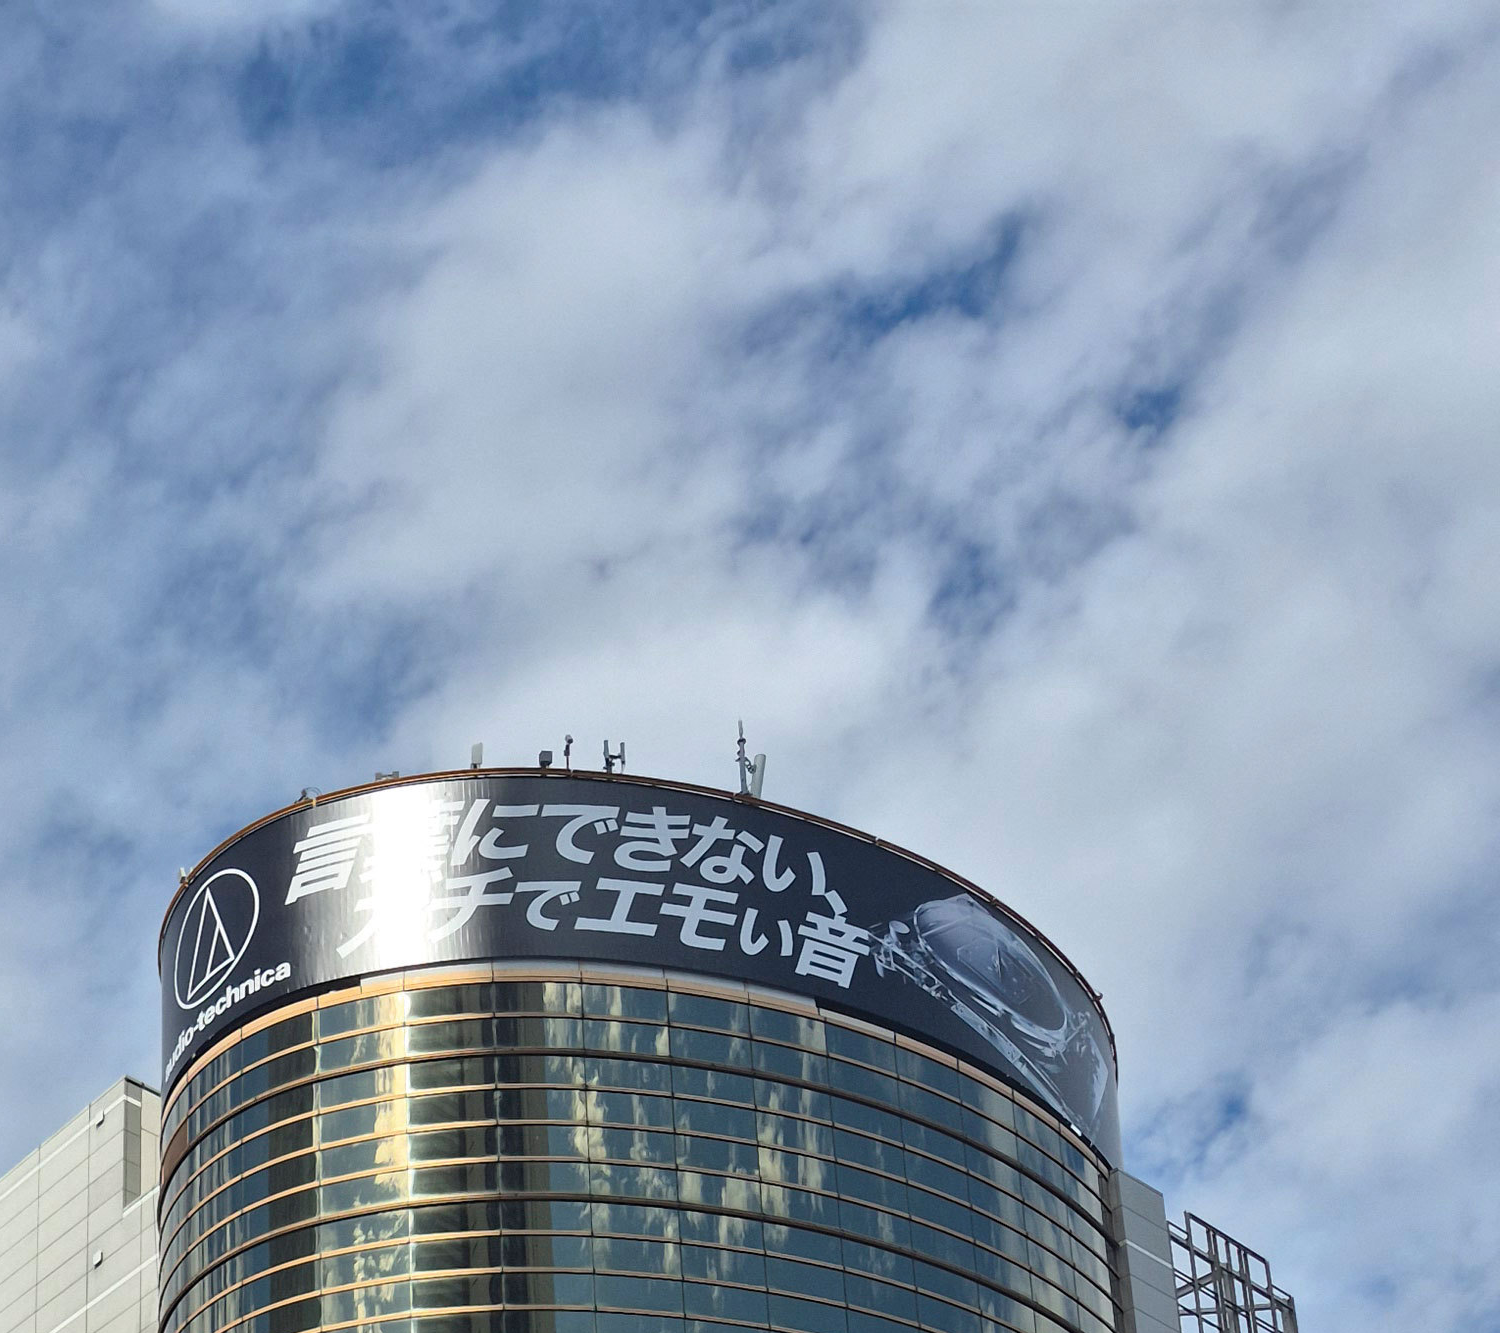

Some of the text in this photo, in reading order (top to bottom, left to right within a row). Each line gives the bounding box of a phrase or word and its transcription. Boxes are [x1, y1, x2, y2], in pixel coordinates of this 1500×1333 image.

[285, 796, 850, 916] 言にできない、
[164, 961, 292, 1082] audio-technica
